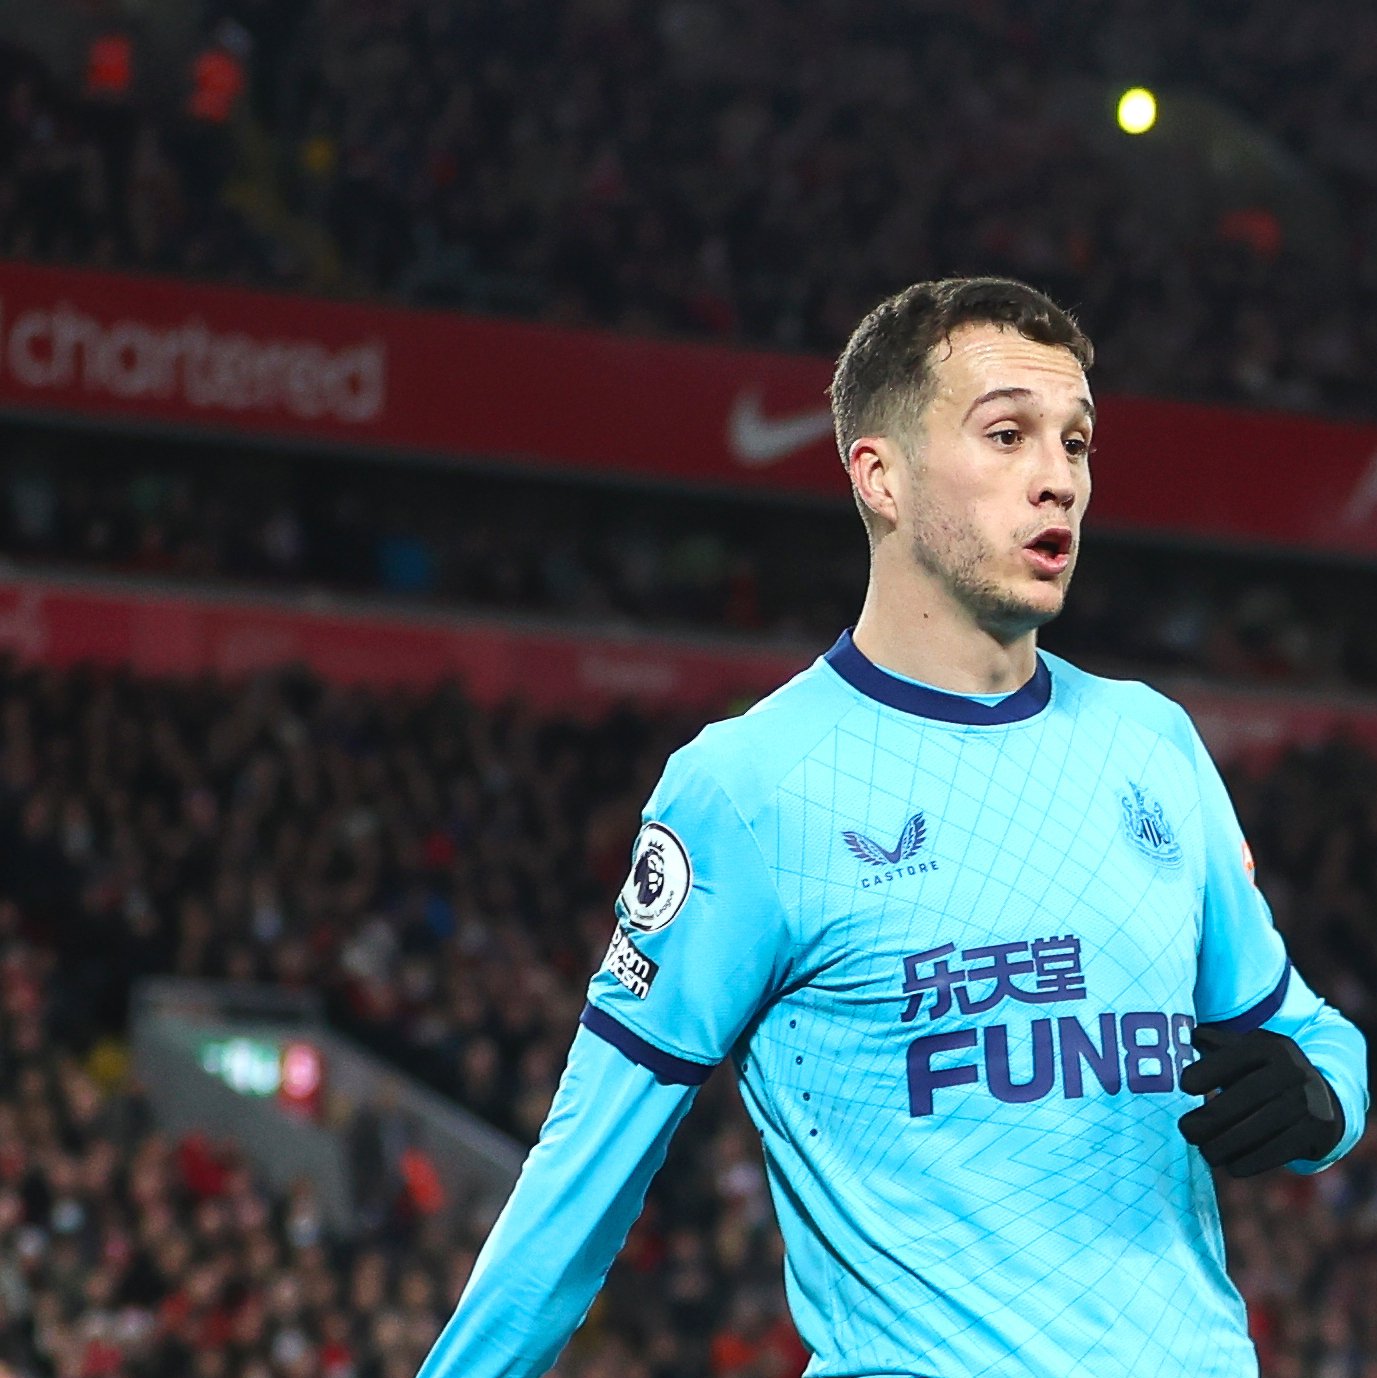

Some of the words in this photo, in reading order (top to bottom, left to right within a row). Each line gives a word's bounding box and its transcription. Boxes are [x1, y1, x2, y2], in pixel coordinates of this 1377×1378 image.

[860, 860, 940, 889] CASTORE
[901, 933, 1088, 1023] 乐天堂
